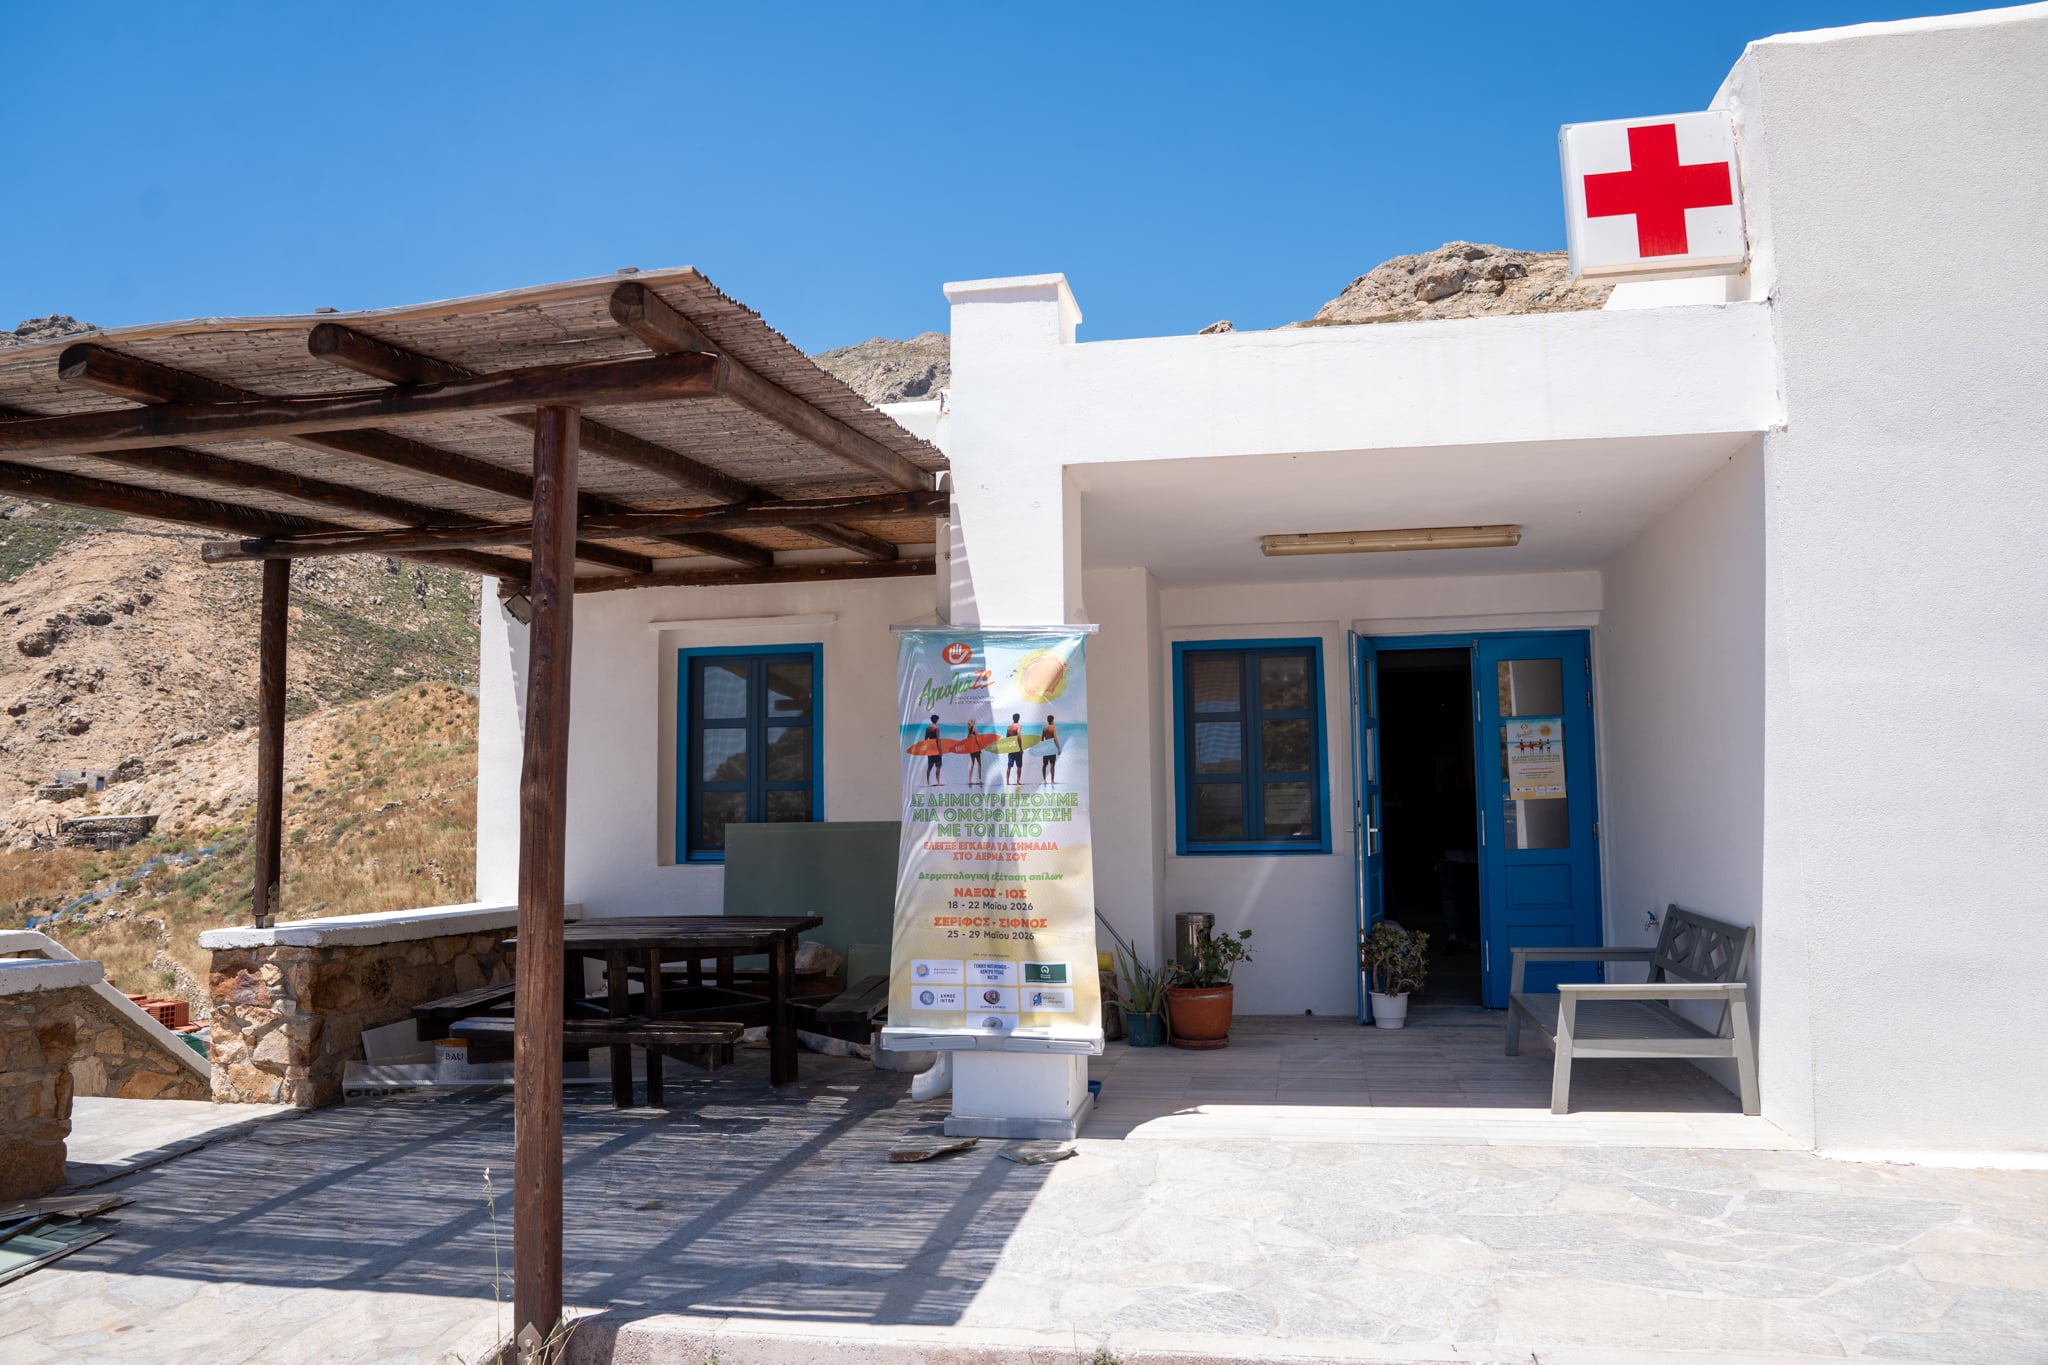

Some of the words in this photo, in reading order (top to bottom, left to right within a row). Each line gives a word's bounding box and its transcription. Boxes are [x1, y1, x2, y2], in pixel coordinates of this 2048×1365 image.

[910, 793, 925, 807] ΑΣ
[928, 792, 1078, 807] ΔΗΜΙΟΥΡΓΗΣΟΥΜΕ
[912, 808, 940, 822] ΜΙΑ
[943, 808, 1017, 822] ΟΜΟΡΦΗ
[1020, 808, 1072, 822] ΣΧΕΣΗ
[937, 824, 961, 837] ΜΕ
[965, 823, 996, 837] ΤΟΝ
[998, 823, 1043, 838] ΗΛΙΟ
[923, 841, 957, 851] ΕΛΕΓΞΕ
[997, 841, 1009, 851] ΤΑ
[1010, 841, 1058, 851] ΣΗΜΑΔΙΑ
[952, 851, 973, 861] ΣΤΟ
[975, 852, 1004, 861] ΔΕΡΜΑ
[1005, 852, 1028, 861] ΣΟΥ
[918, 871, 990, 882] Δερματολογική
[991, 871, 1027, 883] εξέταση
[1028, 871, 1064, 881] σπίλων
[954, 887, 997, 898] ΝΑΞΟΣ
[1005, 888, 1028, 899] ΙΟΣ
[948, 901, 959, 909] 18
[968, 901, 980, 909] 22
[1010, 902, 1034, 911] 2026
[934, 916, 990, 927] ΣΕΡΙΦΟΣ
[998, 917, 1048, 928] ΣΙΦΝΟΣ
[947, 930, 959, 938] 25
[968, 930, 981, 939] 29
[1012, 931, 1035, 941] 2026
